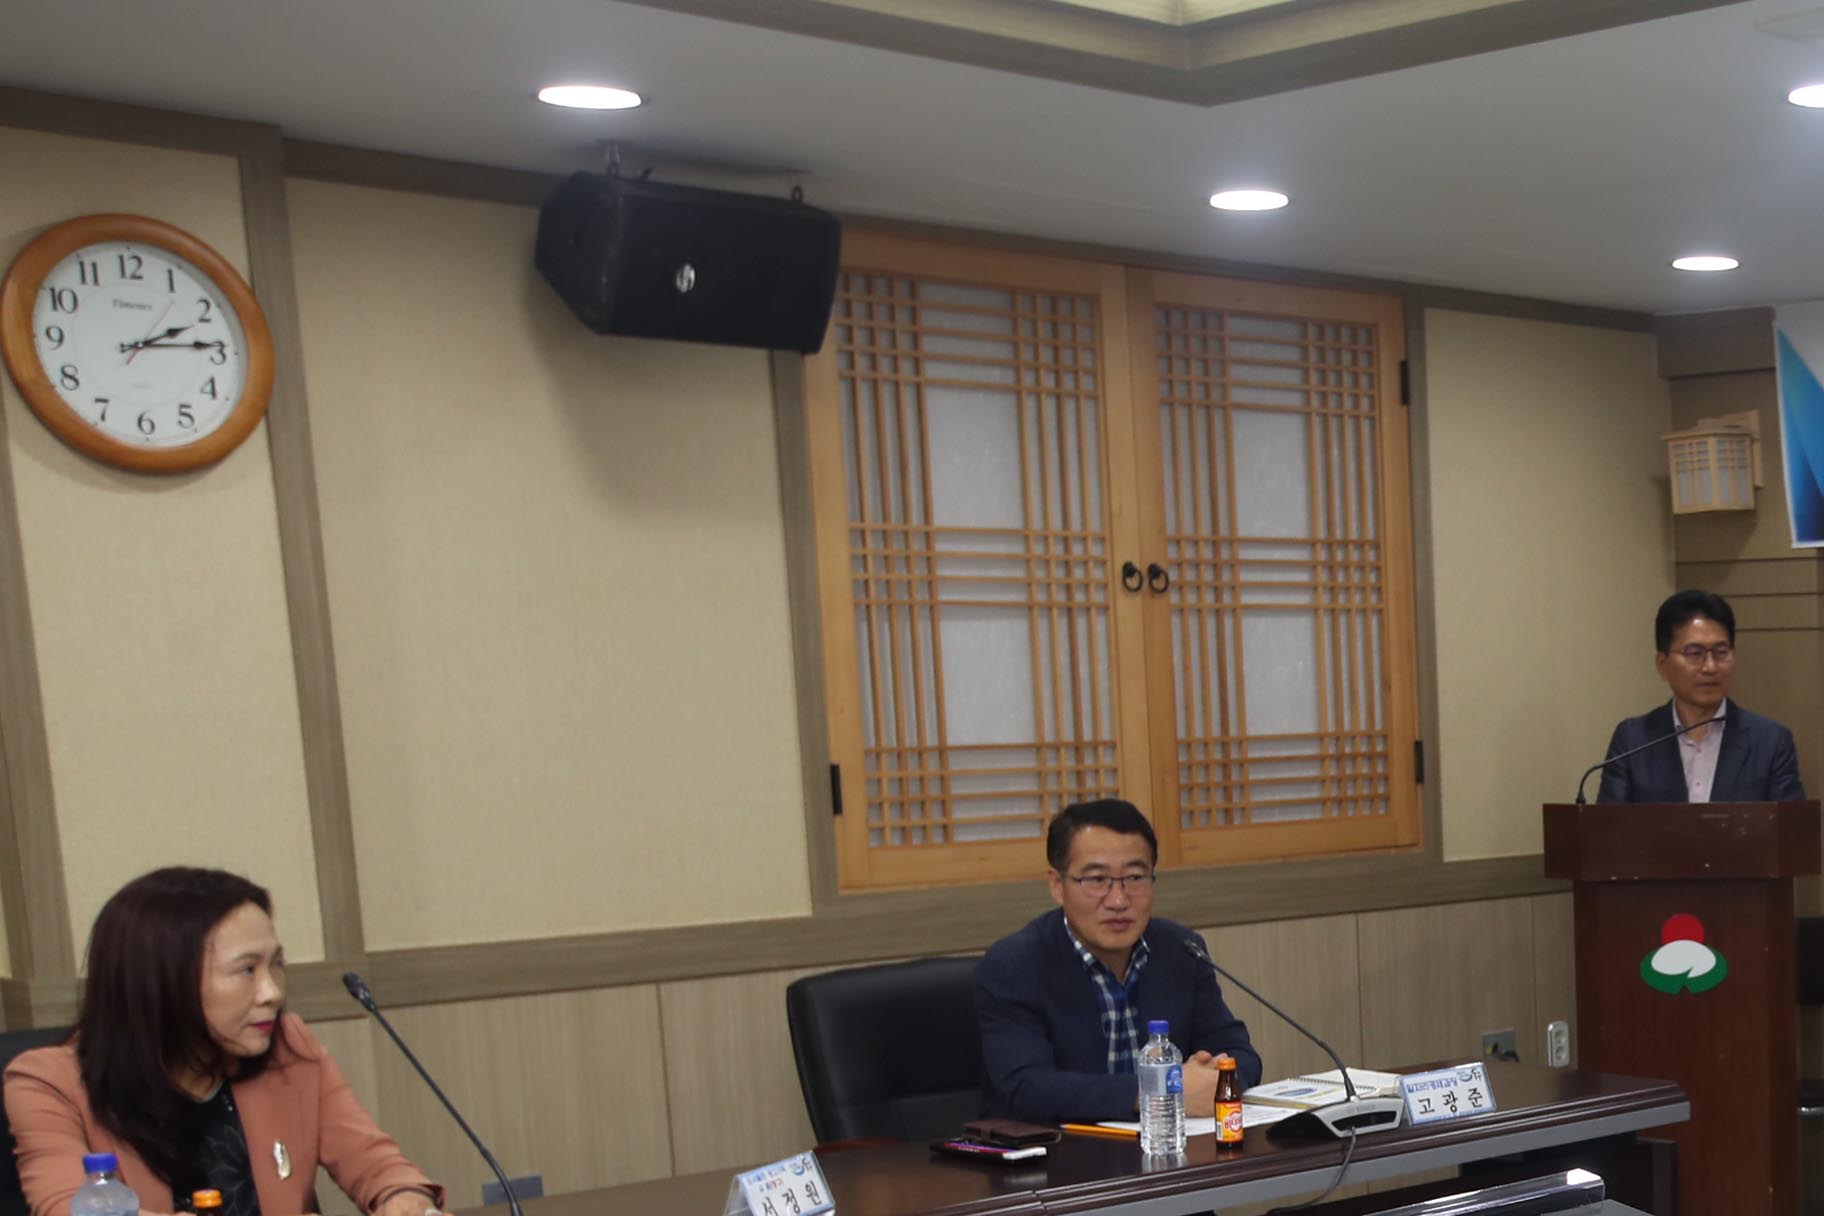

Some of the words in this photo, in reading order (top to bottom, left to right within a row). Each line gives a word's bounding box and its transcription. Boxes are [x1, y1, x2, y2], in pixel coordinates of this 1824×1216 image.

[78, 259, 100, 286] 11
[117, 254, 144, 280] 12
[166, 268, 176, 293] 1
[49, 287, 78, 314] 10
[197, 298, 212, 323] 2
[45, 326, 64, 350] 9
[209, 341, 227, 365] 3
[59, 365, 80, 390] 8
[200, 376, 217, 400] 4
[94, 398, 110, 422] 7
[177, 403, 195, 429] 5
[137, 411, 155, 435] 6
